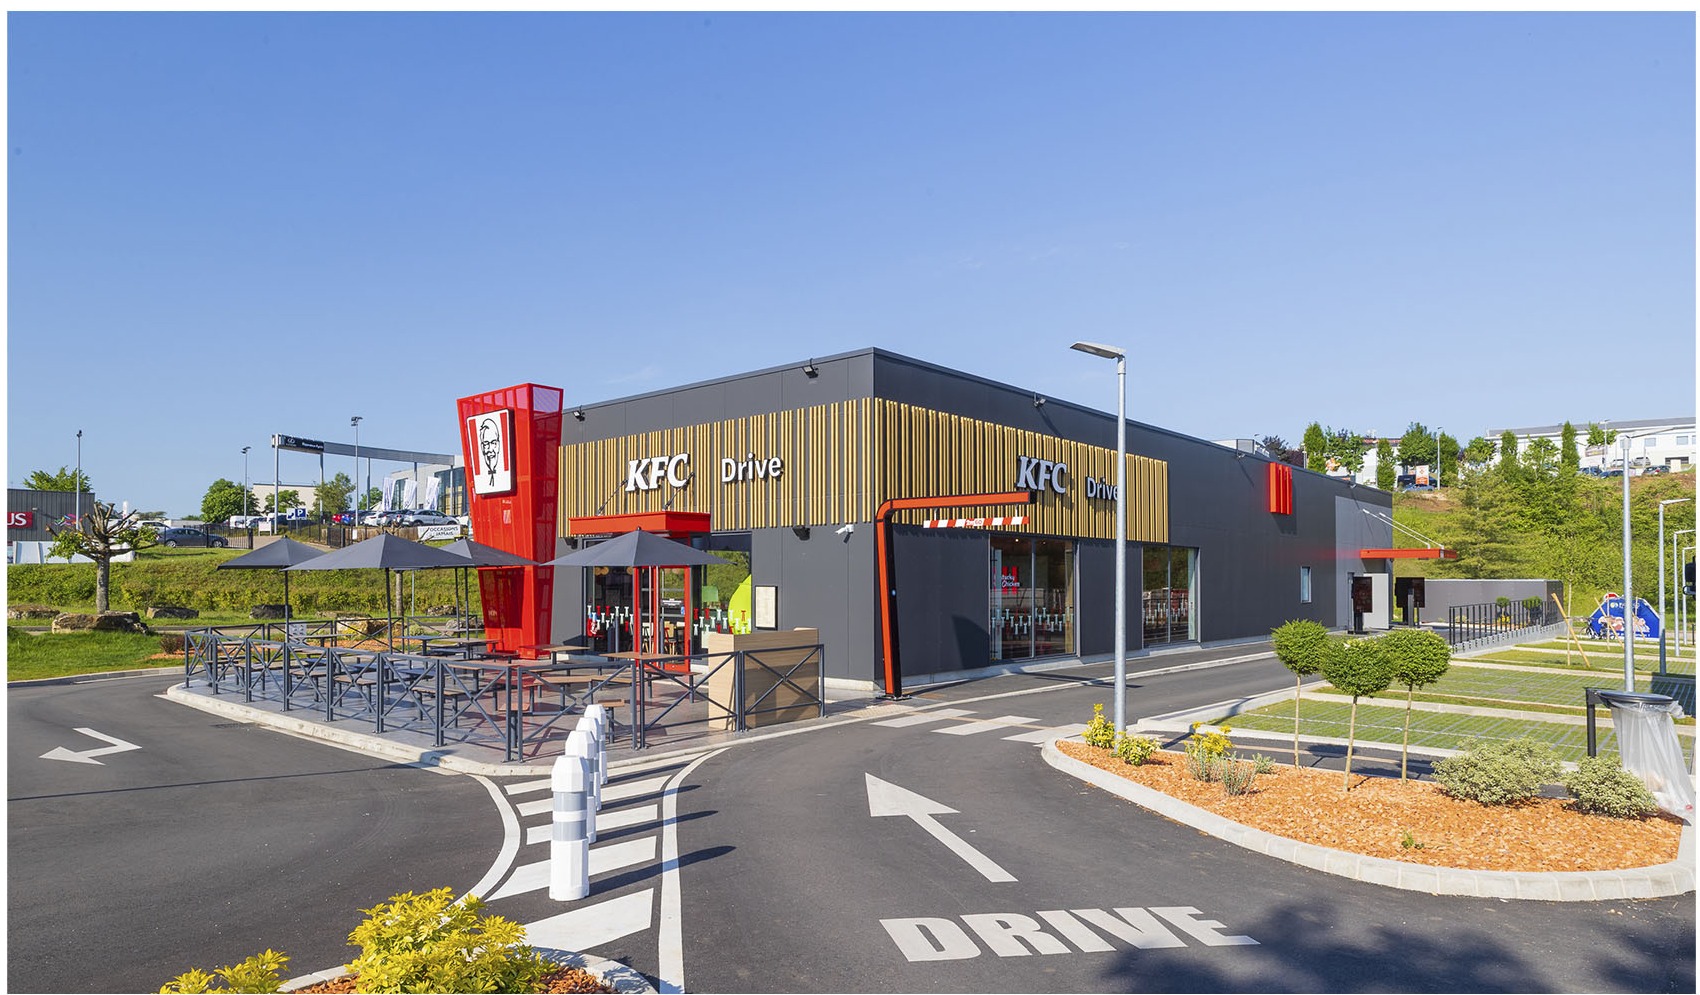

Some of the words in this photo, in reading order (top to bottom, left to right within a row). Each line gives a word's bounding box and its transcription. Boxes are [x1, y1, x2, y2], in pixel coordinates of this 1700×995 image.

[625, 453, 689, 492] KFC
[721, 452, 782, 483] Drive
[1017, 456, 1067, 494] KFC
[297, 509, 304, 517] P
[879, 906, 1261, 963] DRIVE
